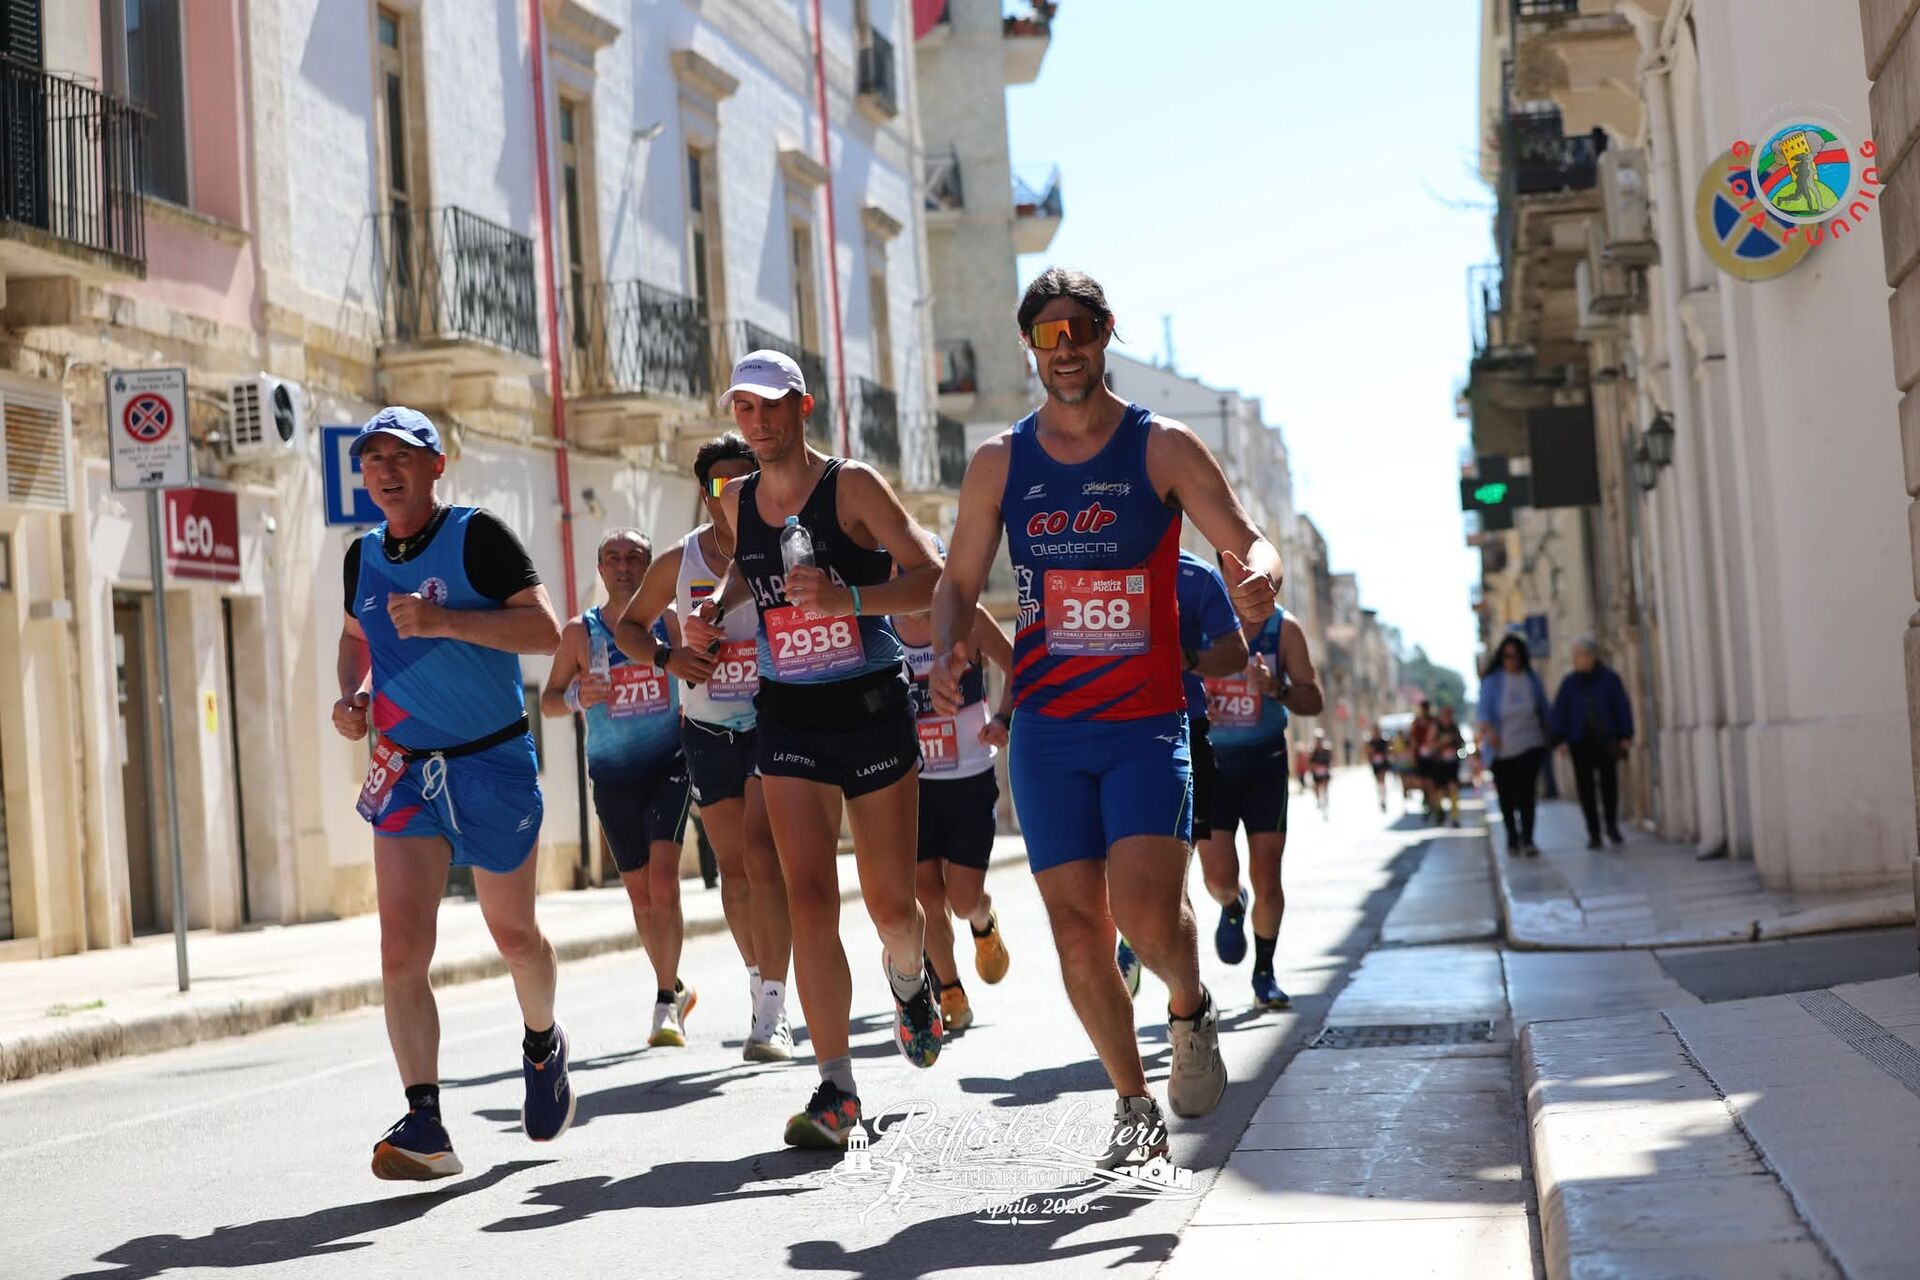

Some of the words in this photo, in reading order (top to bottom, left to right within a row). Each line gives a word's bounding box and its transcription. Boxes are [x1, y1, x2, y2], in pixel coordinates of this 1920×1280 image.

[169, 499, 214, 557] Leo
[1027, 511, 1069, 537] GO
[1073, 501, 1117, 533] UP
[1030, 541, 1118, 556] Oleotecna
[1063, 598, 1130, 630] 368
[775, 621, 852, 659] 2938
[614, 679, 661, 705] 2713
[856, 756, 899, 777] LAPULIA
